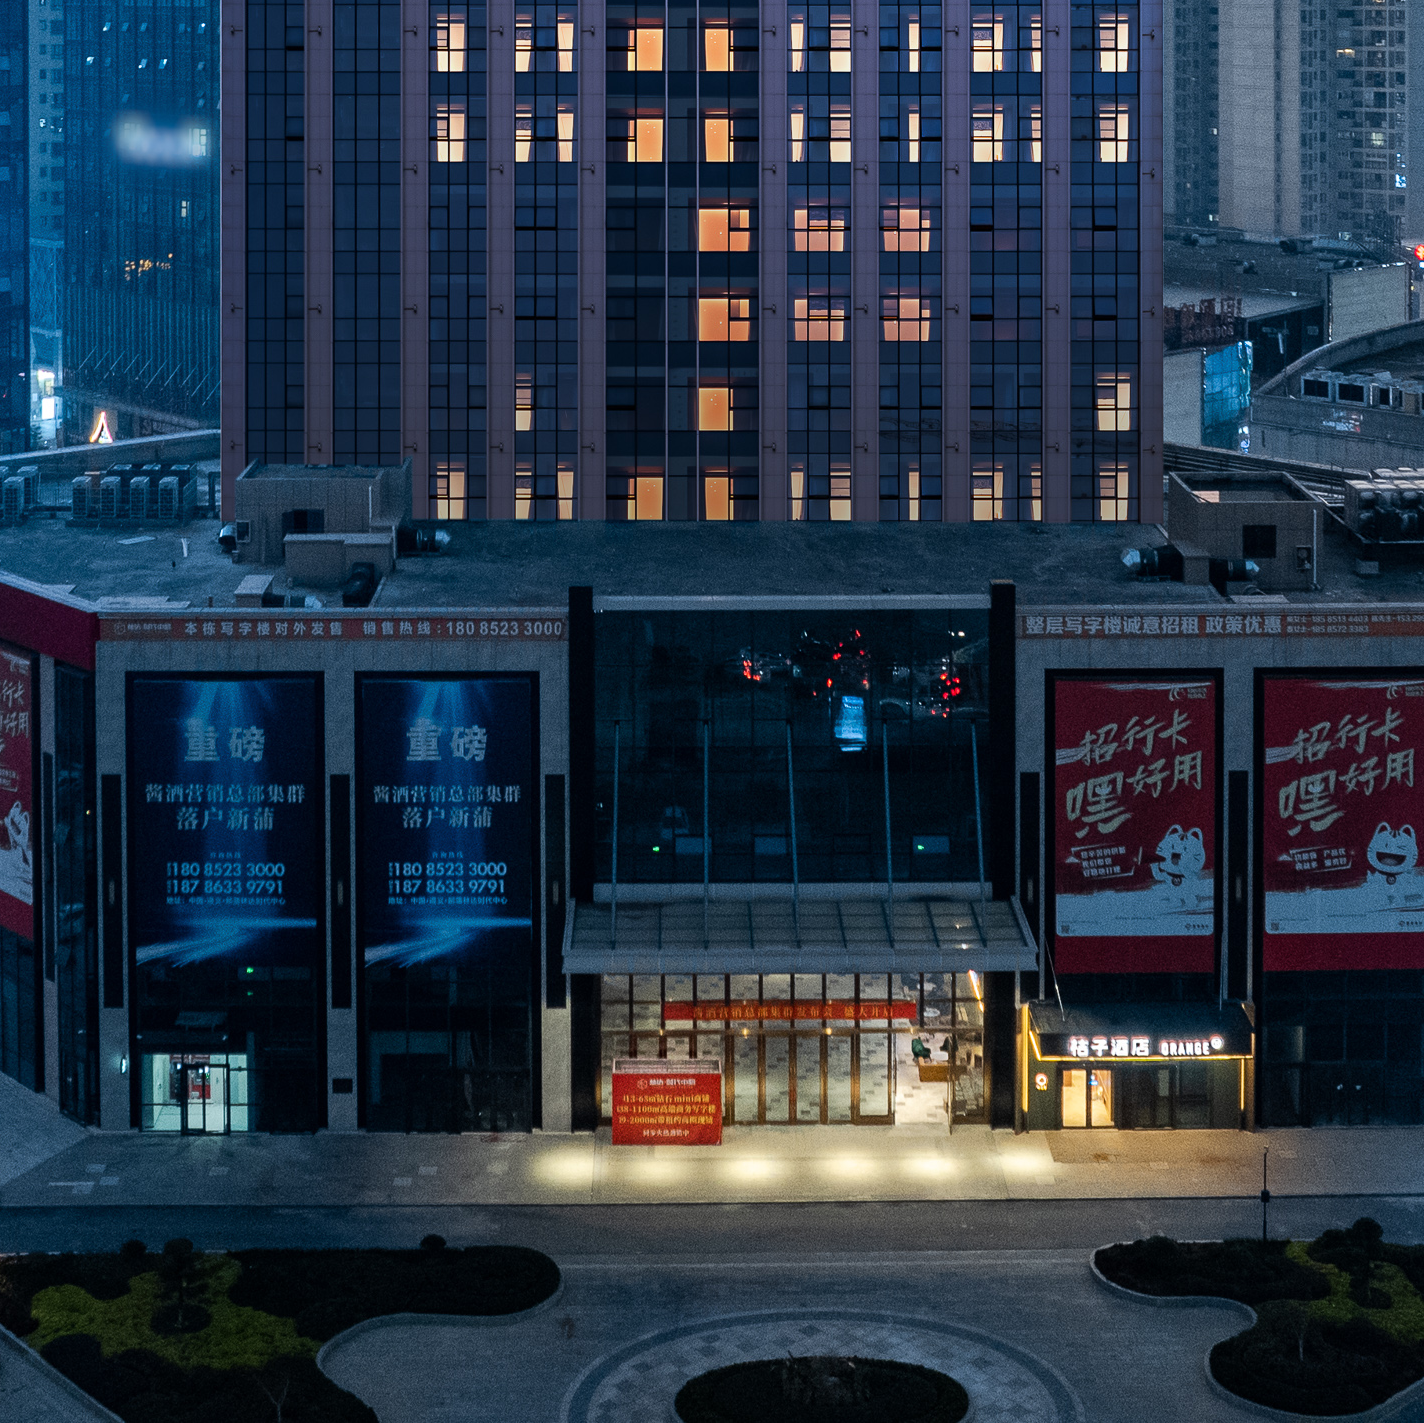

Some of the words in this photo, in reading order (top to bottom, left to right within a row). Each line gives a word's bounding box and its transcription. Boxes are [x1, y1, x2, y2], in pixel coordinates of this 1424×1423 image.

[184, 621, 343, 636] 本栋写字楼对外发售
[446, 622, 475, 636] 180
[479, 622, 519, 636] 8523
[524, 622, 562, 636] 3000
[1026, 616, 1199, 635] 整层写字楼诚意招租
[1205, 616, 1282, 634] 政策优惠
[184, 723, 265, 762] 重磅
[406, 723, 488, 762] 重磅
[1079, 708, 1192, 767] 招行卡
[1293, 707, 1404, 764] 招行卡
[145, 783, 305, 803] 酱酒营销总部集群
[373, 785, 521, 803] 酱酒营销总部集群
[1066, 750, 1202, 840] 嘿好用
[1279, 748, 1415, 837] 嘿好用
[1070, 1035, 1150, 1057] 桔子酒店
[1159, 1041, 1210, 1057] ORANGE
